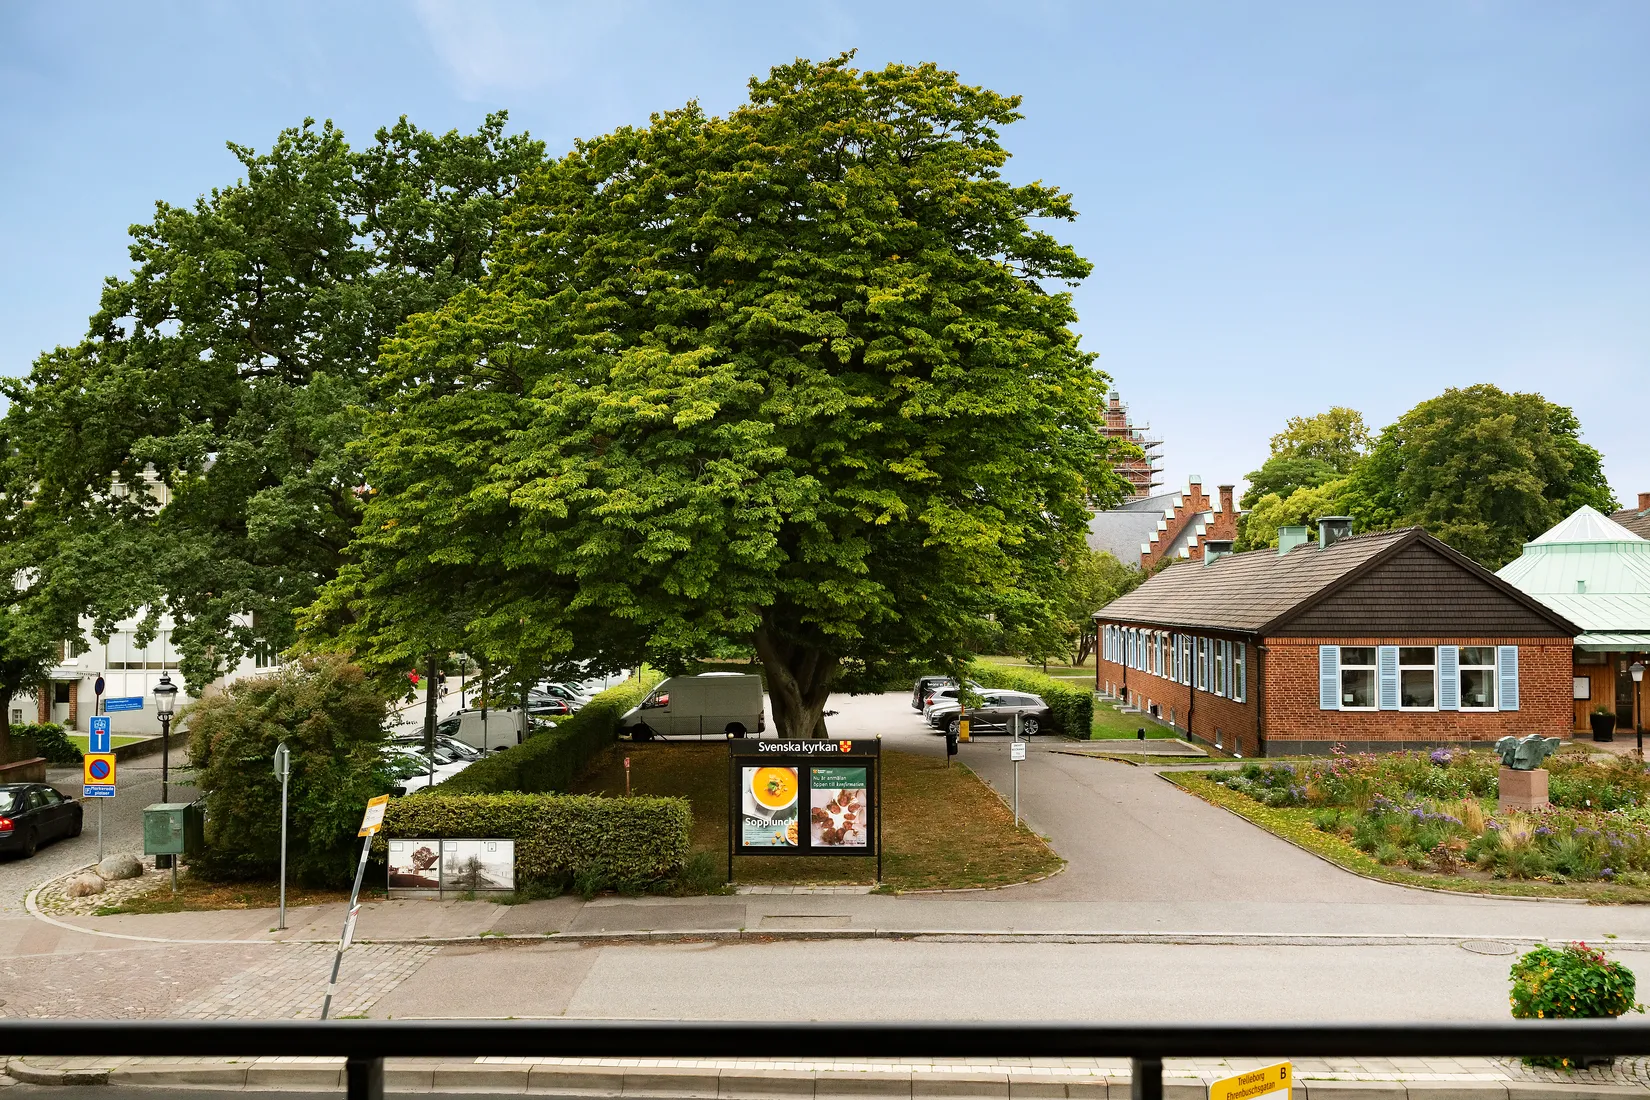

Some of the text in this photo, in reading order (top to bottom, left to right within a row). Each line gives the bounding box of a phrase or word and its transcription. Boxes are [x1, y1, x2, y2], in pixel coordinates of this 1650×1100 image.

[758, 741, 838, 754] Svenska kyrkan
[745, 817, 795, 828] Sopplunch
[1238, 1072, 1265, 1086] Trelleborg
[1280, 1067, 1287, 1080] B
[1226, 1081, 1276, 1100] Ehrenbuschsgatan
